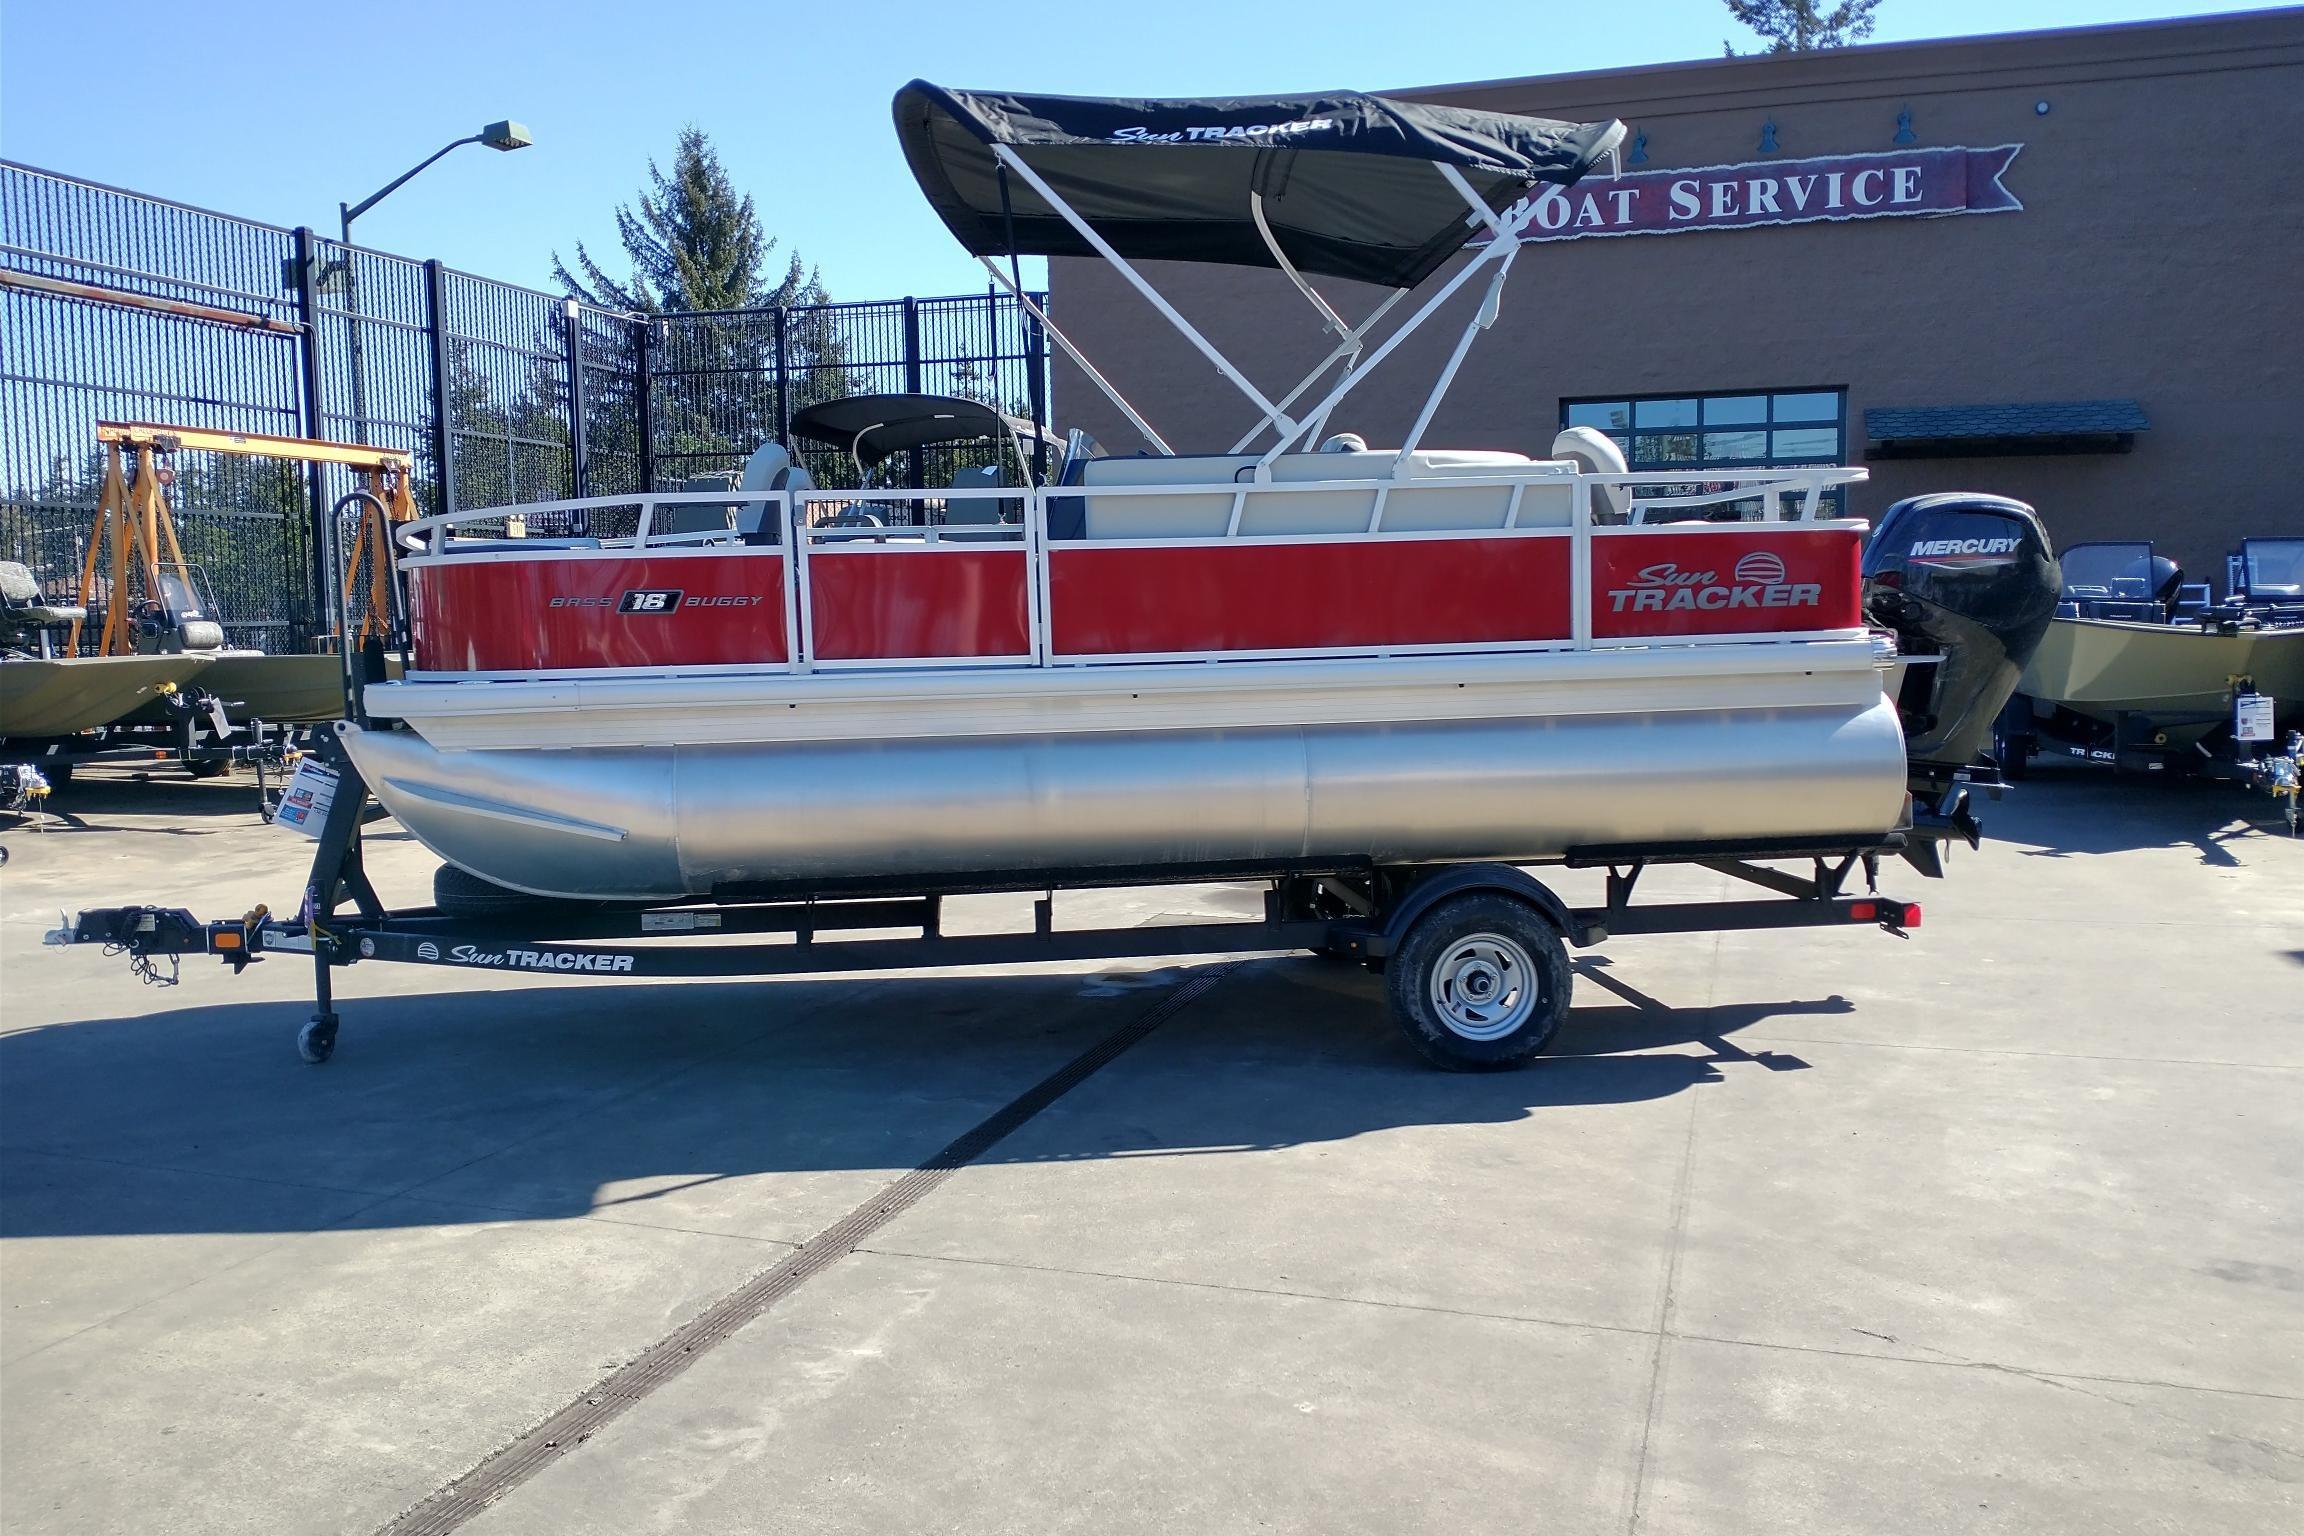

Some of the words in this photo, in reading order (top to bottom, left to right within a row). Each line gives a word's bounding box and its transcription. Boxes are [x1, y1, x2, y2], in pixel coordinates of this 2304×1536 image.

[1105, 126, 1184, 142] Sun
[1186, 118, 1333, 140] TRACKER
[1669, 166, 1923, 220] SERVICE
[1910, 538, 2022, 556] MERCURY
[1626, 563, 1718, 587] Sun
[550, 597, 613, 608] BASS
[632, 593, 668, 610] 18
[685, 596, 763, 607] BUGGY
[1608, 583, 1822, 612] TRACKER
[2070, 747, 2115, 760] TRCK
[445, 945, 505, 964] Sun
[506, 949, 634, 971] TRACKER
